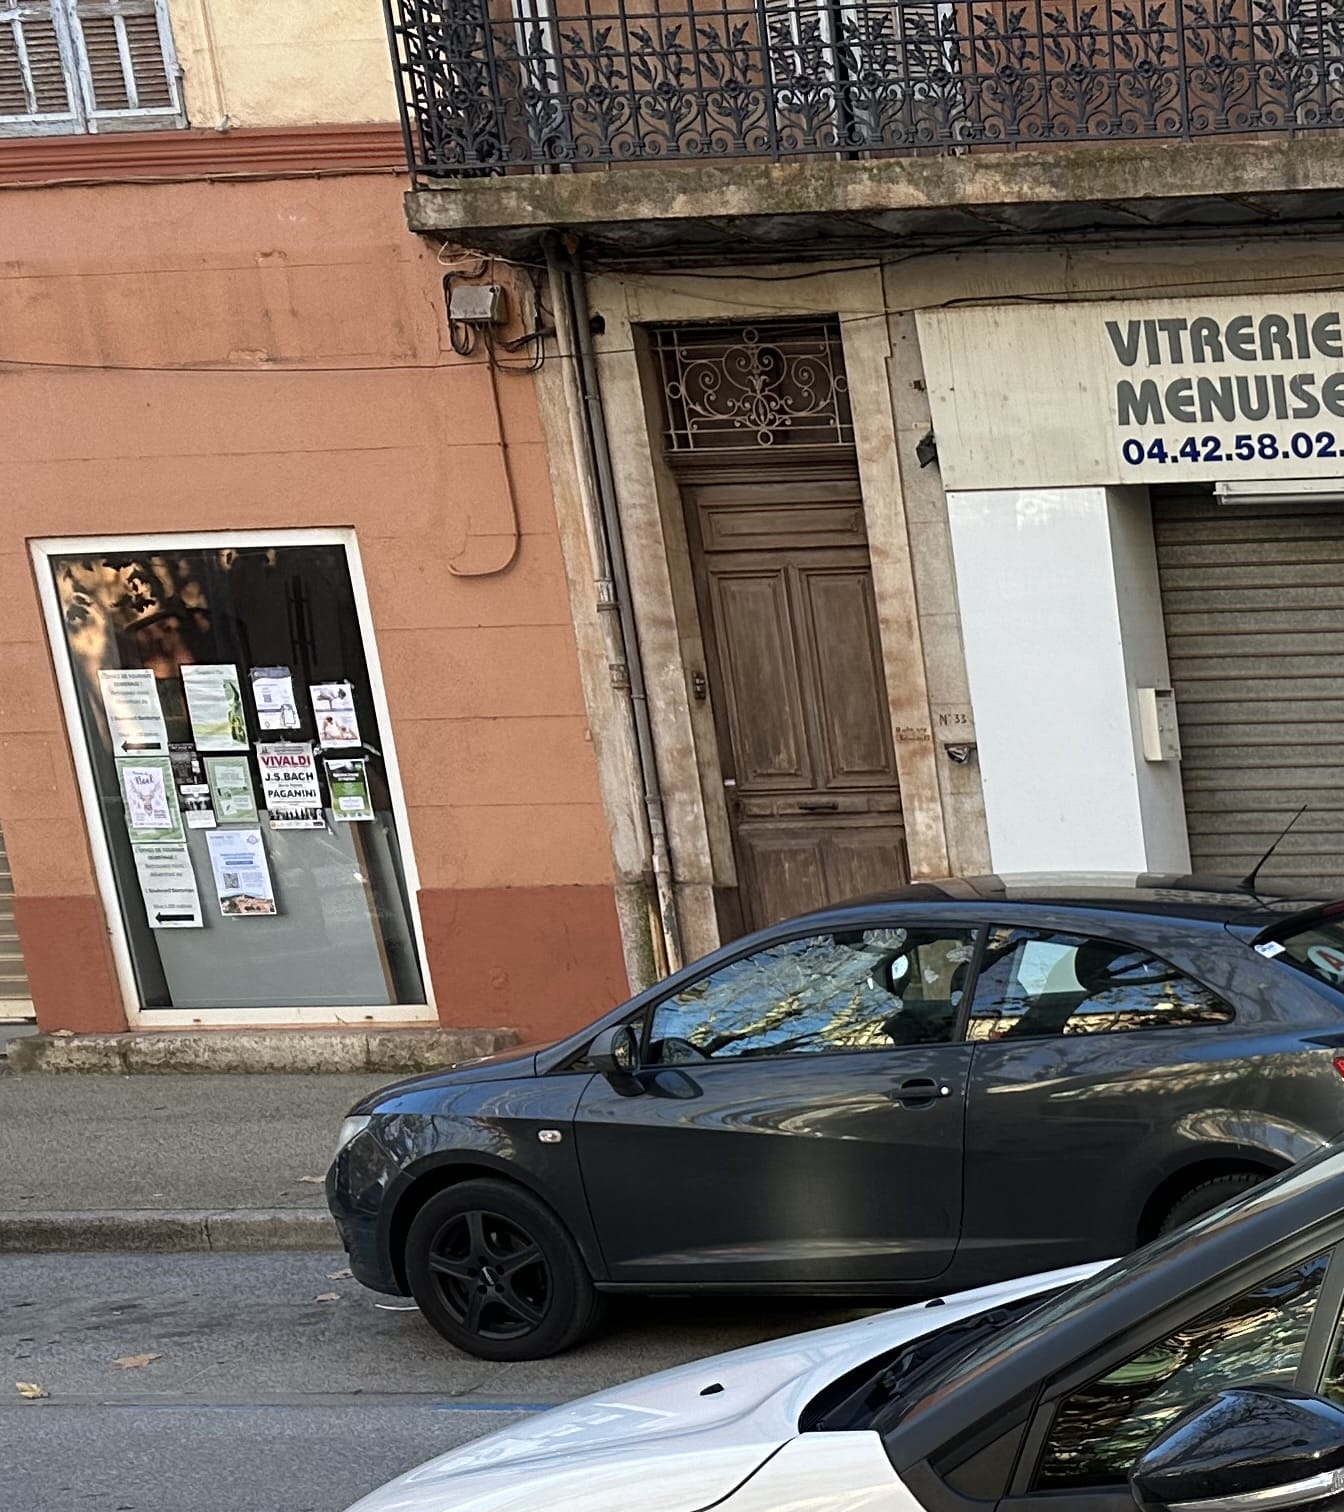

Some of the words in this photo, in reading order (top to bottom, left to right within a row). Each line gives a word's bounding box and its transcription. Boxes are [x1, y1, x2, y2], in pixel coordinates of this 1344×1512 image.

[1105, 312, 1343, 367] VITRERIE
[261, 755, 311, 766] VIVALDI
[268, 789, 317, 799] PAGANINI
